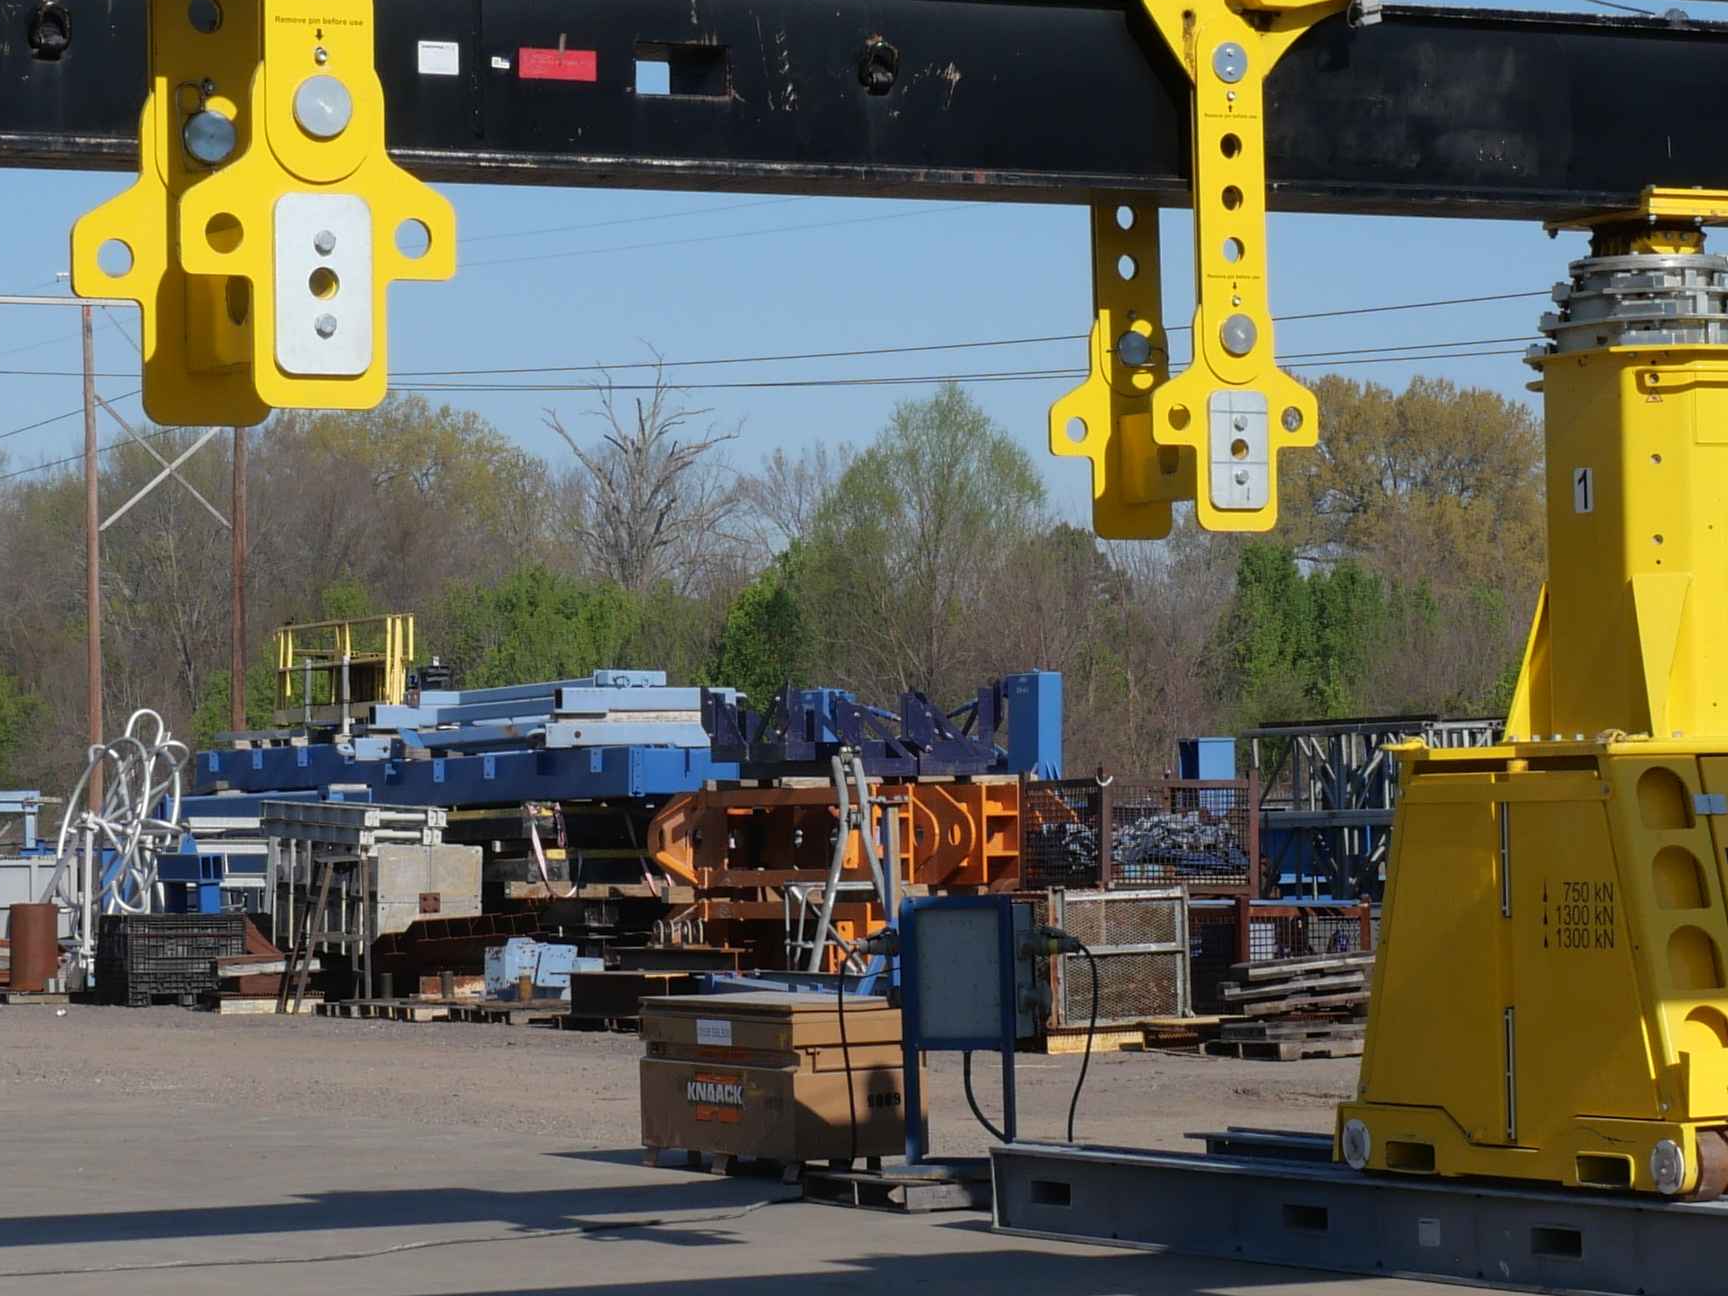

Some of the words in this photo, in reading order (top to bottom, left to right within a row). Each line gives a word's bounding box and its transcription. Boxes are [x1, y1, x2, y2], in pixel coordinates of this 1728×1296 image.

[1578, 469, 1588, 510] 1
[1563, 881, 1590, 903] 750
[1595, 882, 1614, 903] kN
[1556, 904, 1590, 926] 1300
[1595, 905, 1614, 926] kN
[1556, 927, 1590, 950] 1300
[1595, 928, 1614, 950] kN
[687, 1081, 743, 1105] KNAACK
